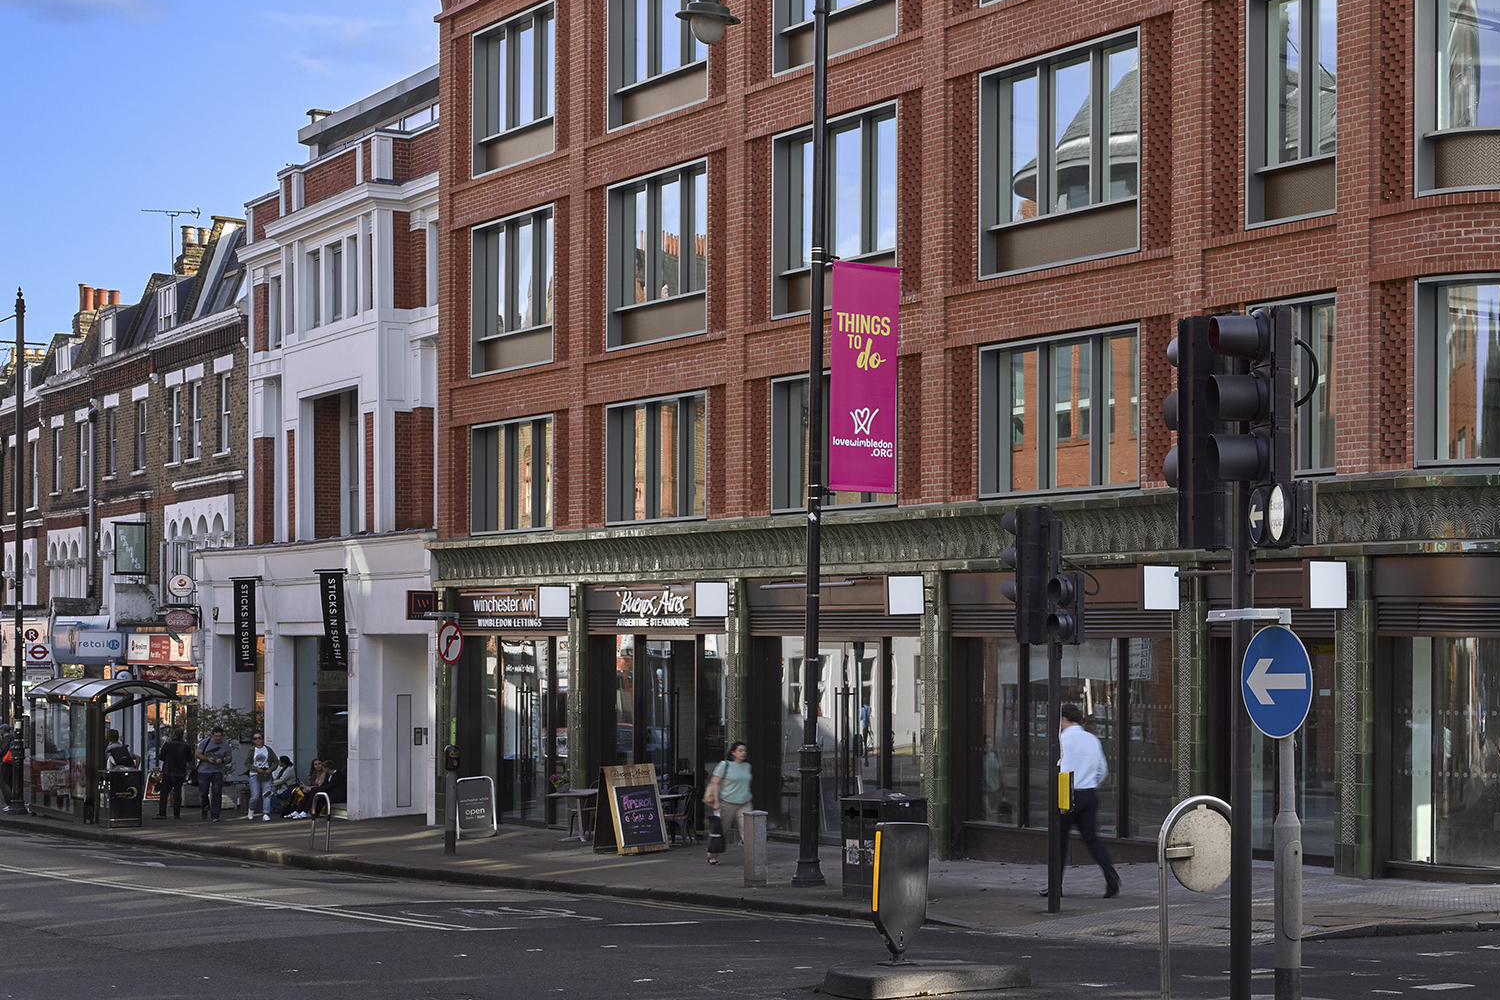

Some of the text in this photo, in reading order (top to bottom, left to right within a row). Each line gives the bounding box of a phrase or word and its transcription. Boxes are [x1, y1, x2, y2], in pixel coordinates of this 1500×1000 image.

[836, 312, 891, 336] THINGS
[847, 334, 862, 350] TO
[856, 338, 887, 371] do
[832, 436, 893, 449] lovewimbledon
[871, 448, 893, 458] .ORG
[1270, 500, 1284, 511] Excep
[118, 529, 141, 569] FRAMING
[240, 584, 249, 617] STICKS
[327, 578, 337, 615] STICKS
[473, 595, 520, 612] winchester
[616, 590, 689, 617] Buenos Aires
[477, 618, 543, 627] WIMBLEDON LETTINGS
[616, 618, 690, 627] ARGENTINE STEAKHOUSE
[28, 630, 36, 639] R
[465, 808, 486, 816] open
